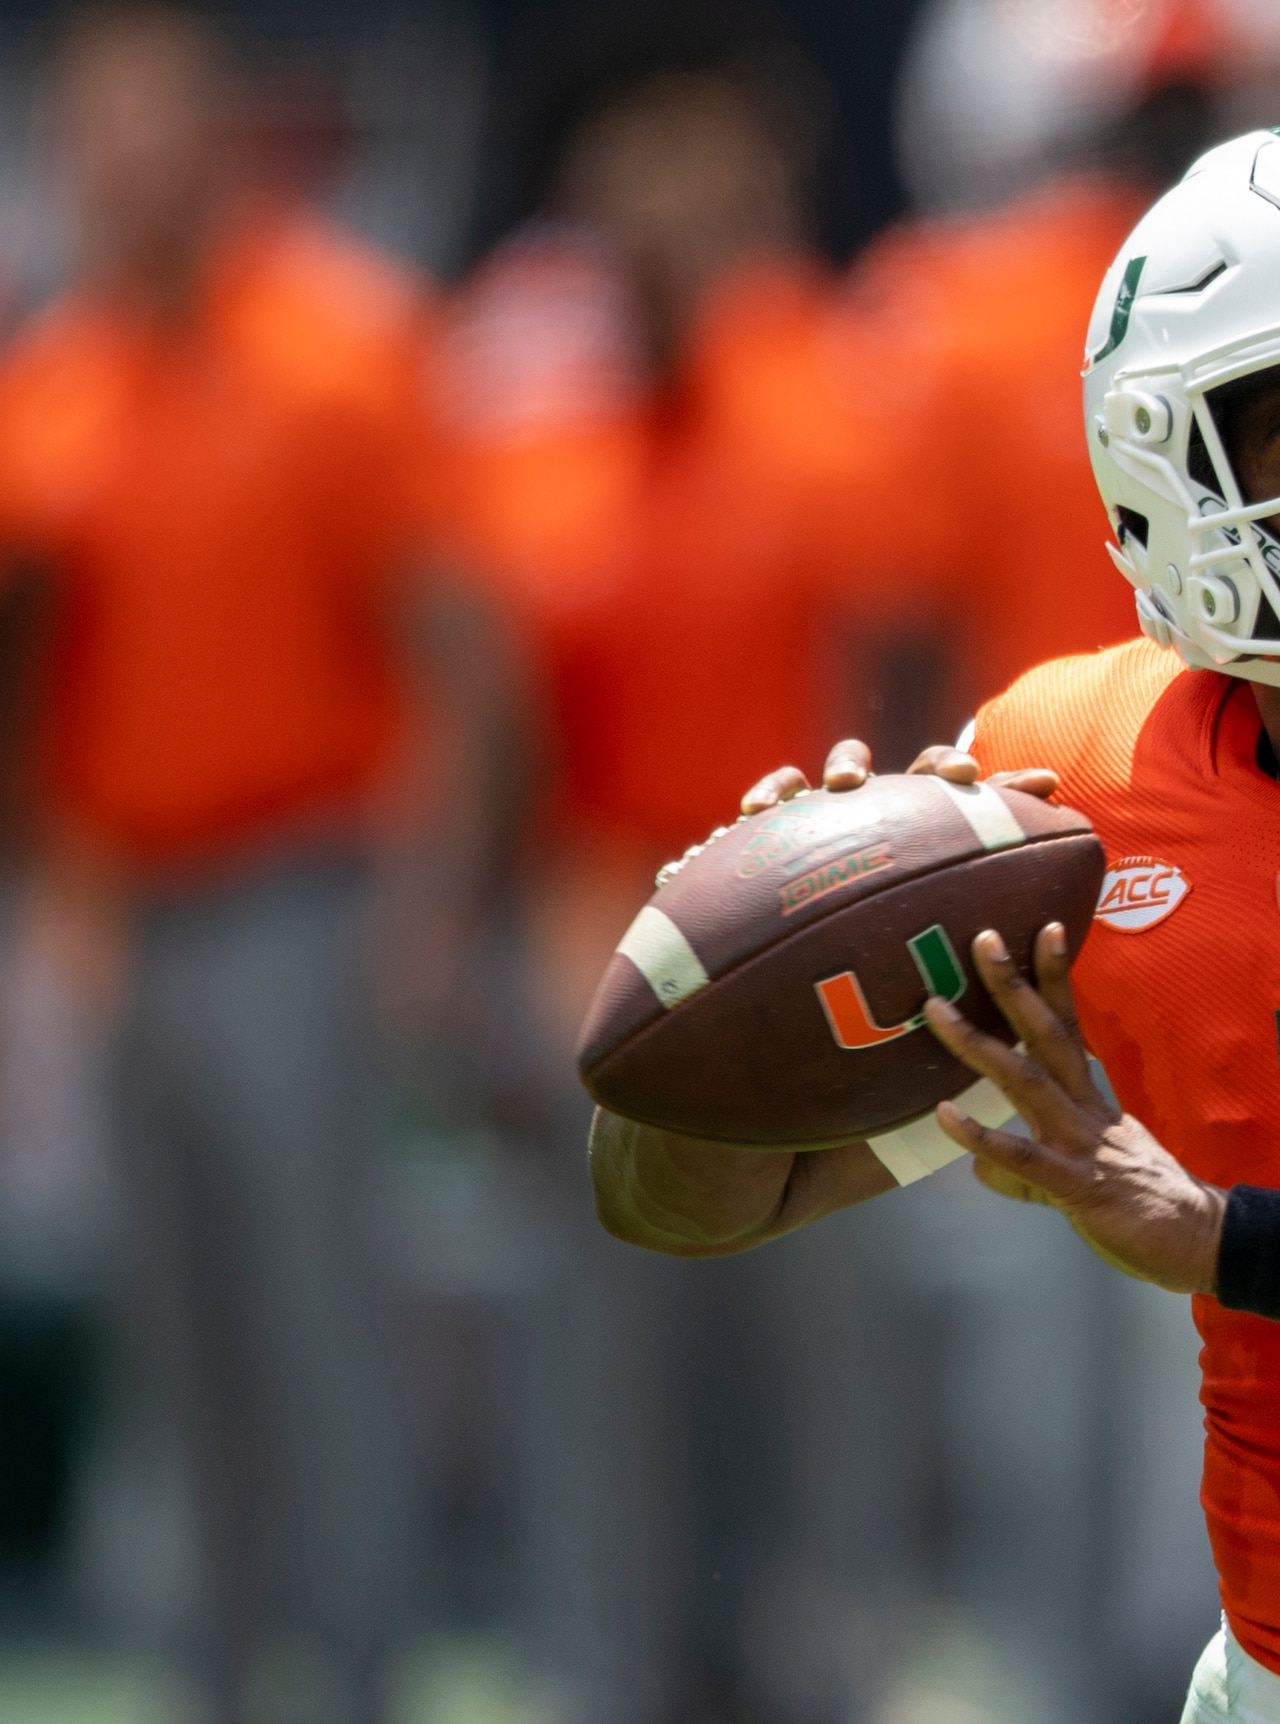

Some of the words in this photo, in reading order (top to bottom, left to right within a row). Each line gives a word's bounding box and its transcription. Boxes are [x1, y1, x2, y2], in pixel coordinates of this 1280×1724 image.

[784, 845, 890, 909] DIME
[1100, 869, 1174, 908] ACC
[813, 924, 967, 1050] U
